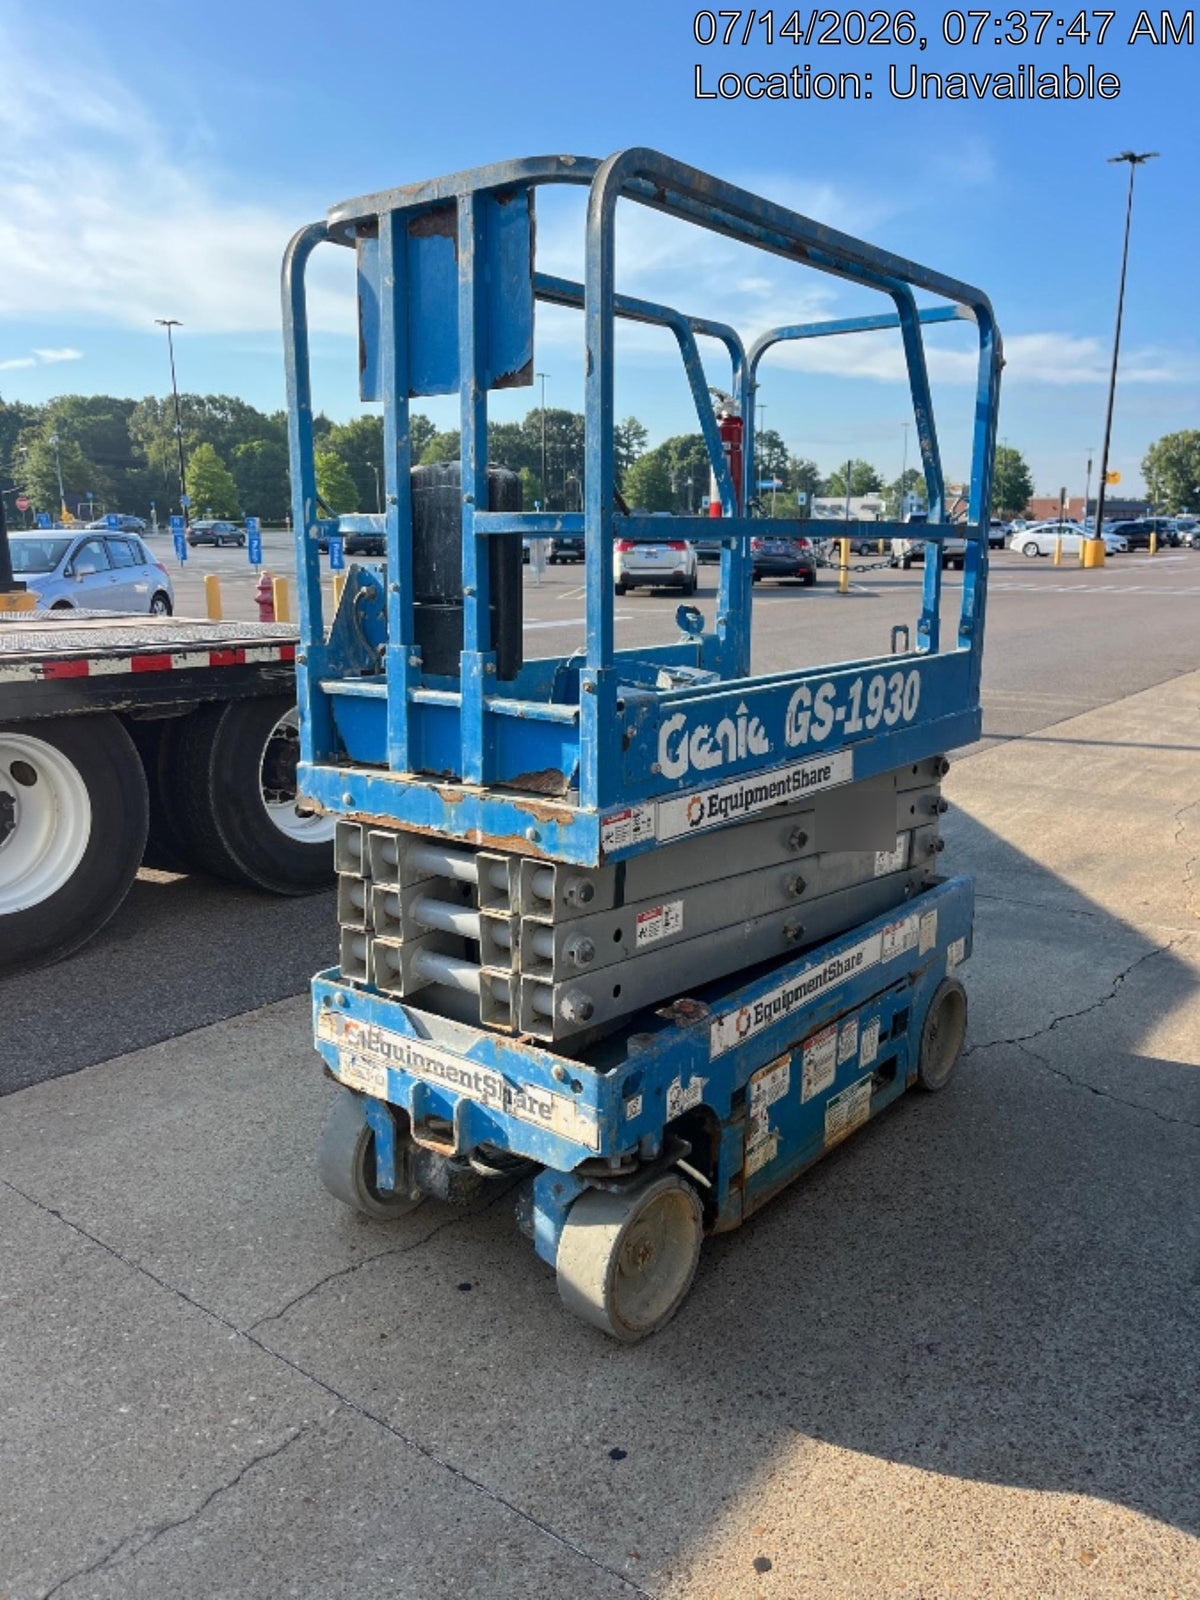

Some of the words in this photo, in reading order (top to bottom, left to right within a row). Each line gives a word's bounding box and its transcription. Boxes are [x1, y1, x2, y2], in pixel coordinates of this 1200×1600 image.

[657, 701, 769, 780] Genie
[785, 670, 921, 748] GS-1930
[706, 765, 832, 819] EquipmentShare
[752, 950, 864, 1026] EquipmentShare
